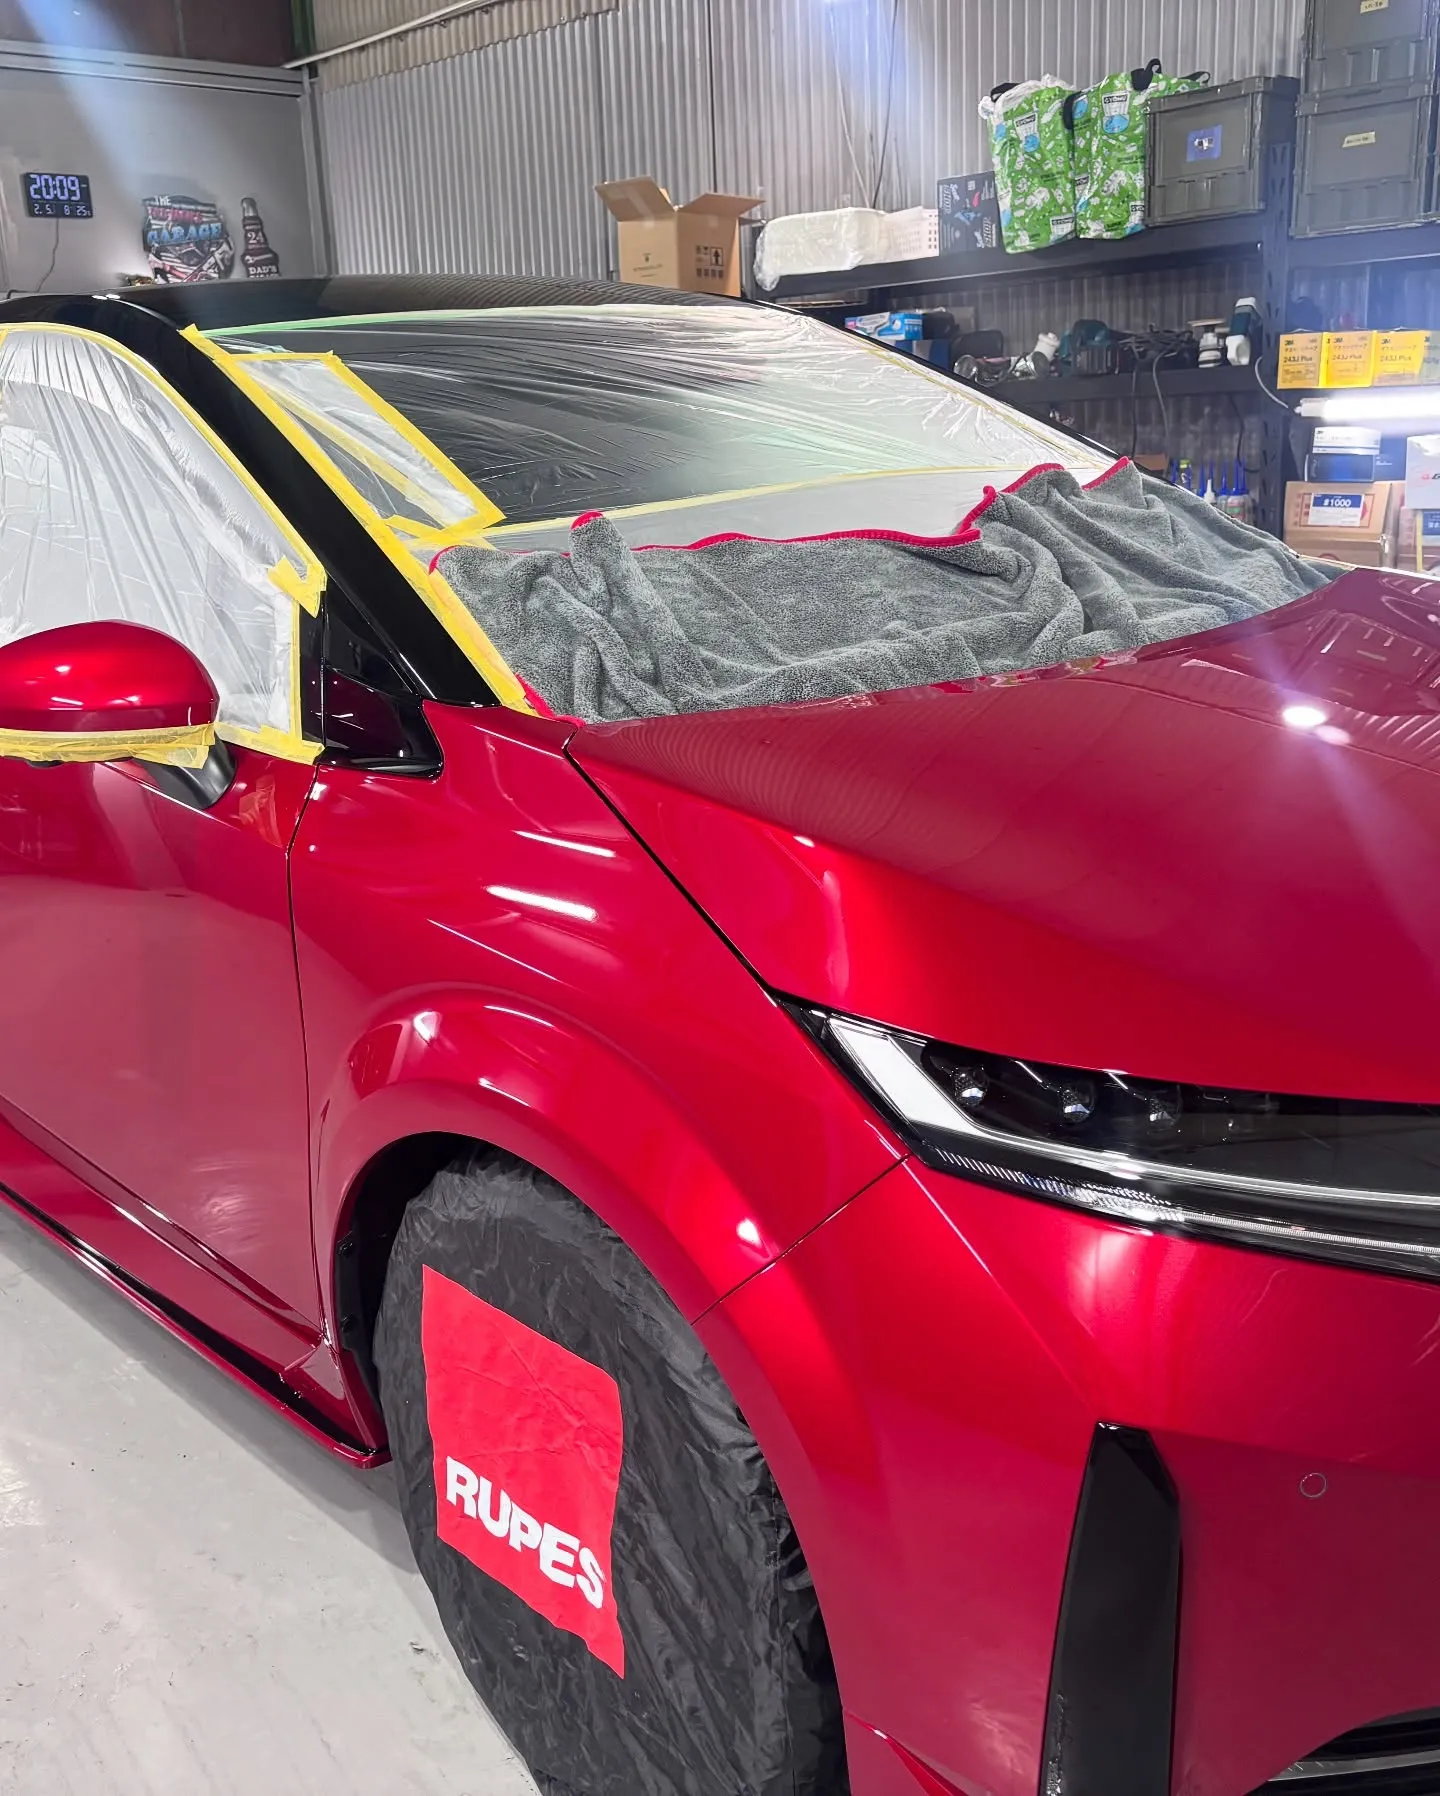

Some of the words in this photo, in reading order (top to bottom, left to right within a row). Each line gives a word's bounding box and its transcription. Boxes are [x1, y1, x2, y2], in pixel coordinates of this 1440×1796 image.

[30, 174, 81, 201] 20:09
[155, 196, 172, 206] THE
[148, 222, 223, 246] GARAGE
[246, 231, 264, 244] 24
[249, 265, 278, 275] DAD'S
[1323, 498, 1351, 507] #1000
[446, 1456, 606, 1609] RUPES
